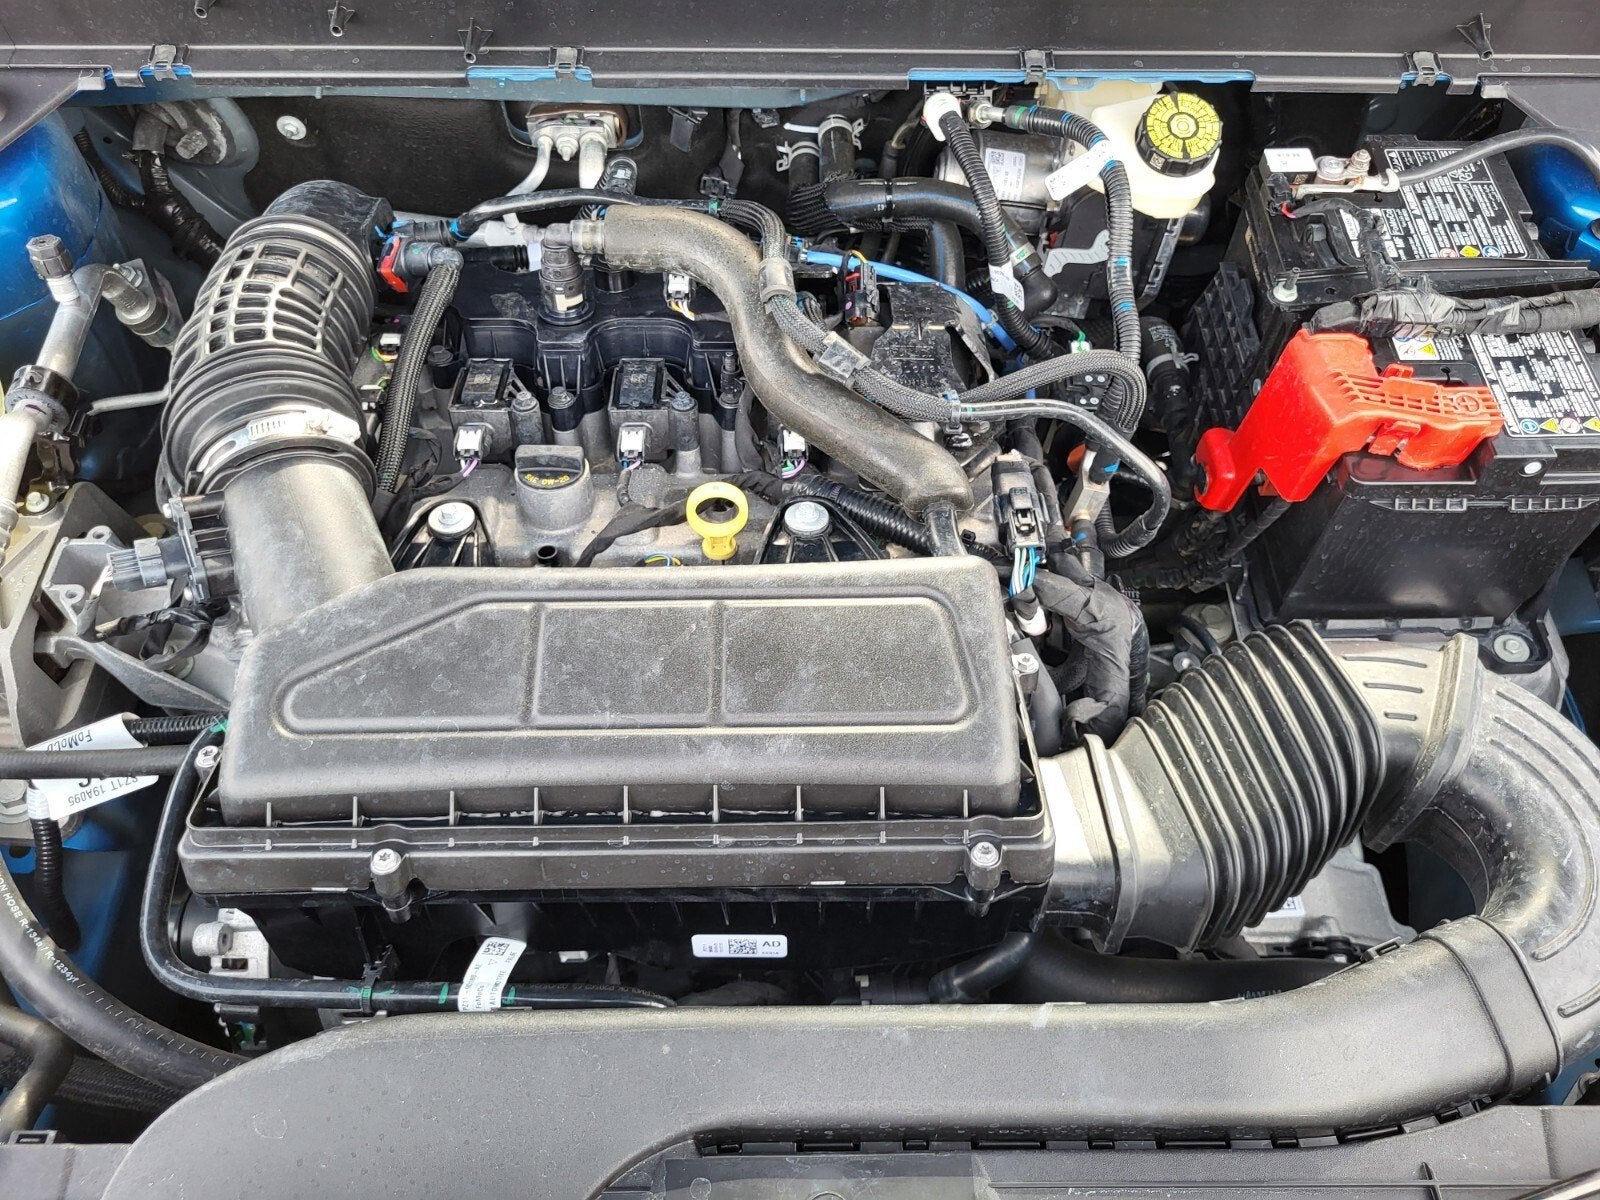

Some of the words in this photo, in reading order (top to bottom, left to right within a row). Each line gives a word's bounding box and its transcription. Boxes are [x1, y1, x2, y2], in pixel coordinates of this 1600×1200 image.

[524, 473, 540, 484] SAE
[68, 785, 106, 806] 19A095
[3, 892, 24, 919] HOSE
[762, 940, 781, 948] AD
